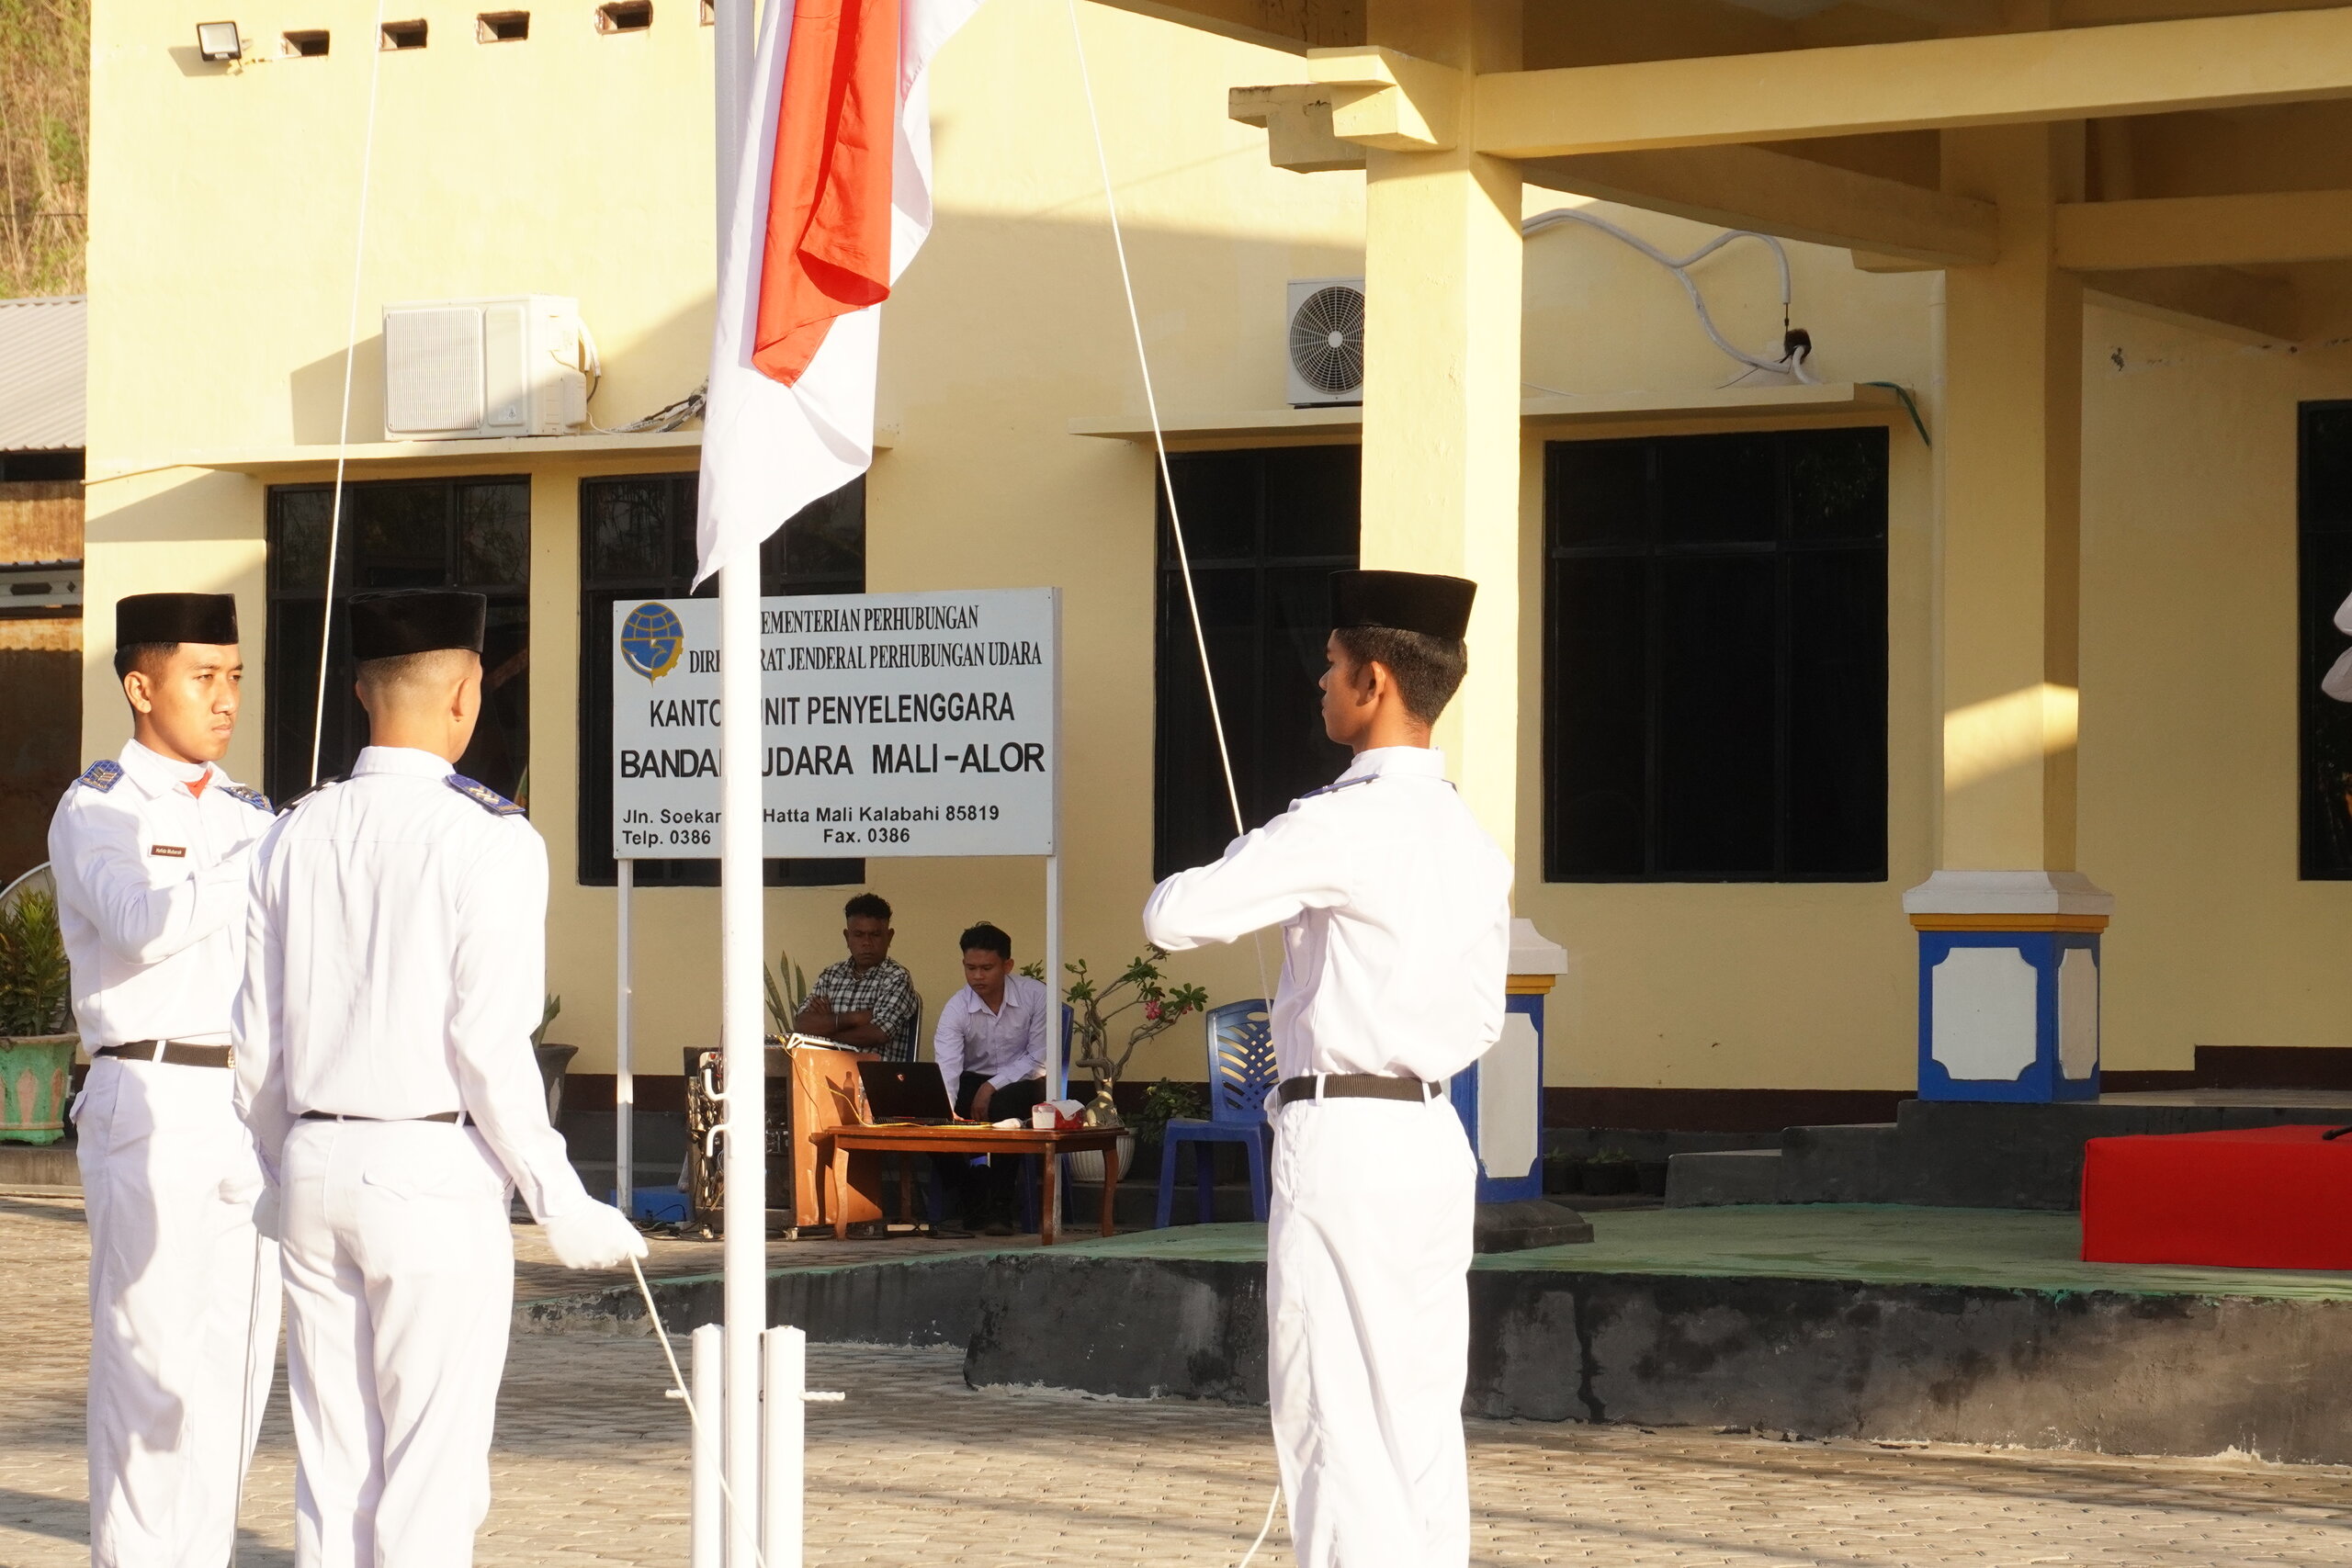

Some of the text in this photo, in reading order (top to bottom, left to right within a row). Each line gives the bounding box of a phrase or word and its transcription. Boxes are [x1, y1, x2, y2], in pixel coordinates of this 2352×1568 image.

[761, 604, 978, 634] EMENTERIAN PERHUBUNGAN
[787, 645, 866, 671] JENDERAL
[869, 642, 985, 669] PERHUBUNGAN
[989, 640, 1042, 666] UDARA
[650, 692, 1015, 728] KANTO NIT PENYELENGGARA
[620, 748, 721, 778] BANDA
[623, 809, 653, 824] Jln.
[763, 807, 809, 822] Hatta
[816, 807, 853, 822] Mali
[859, 806, 939, 822] Kalabahi
[945, 805, 1000, 821] 85819
[622, 828, 910, 849] Telp. 0386 Fax. 0386
